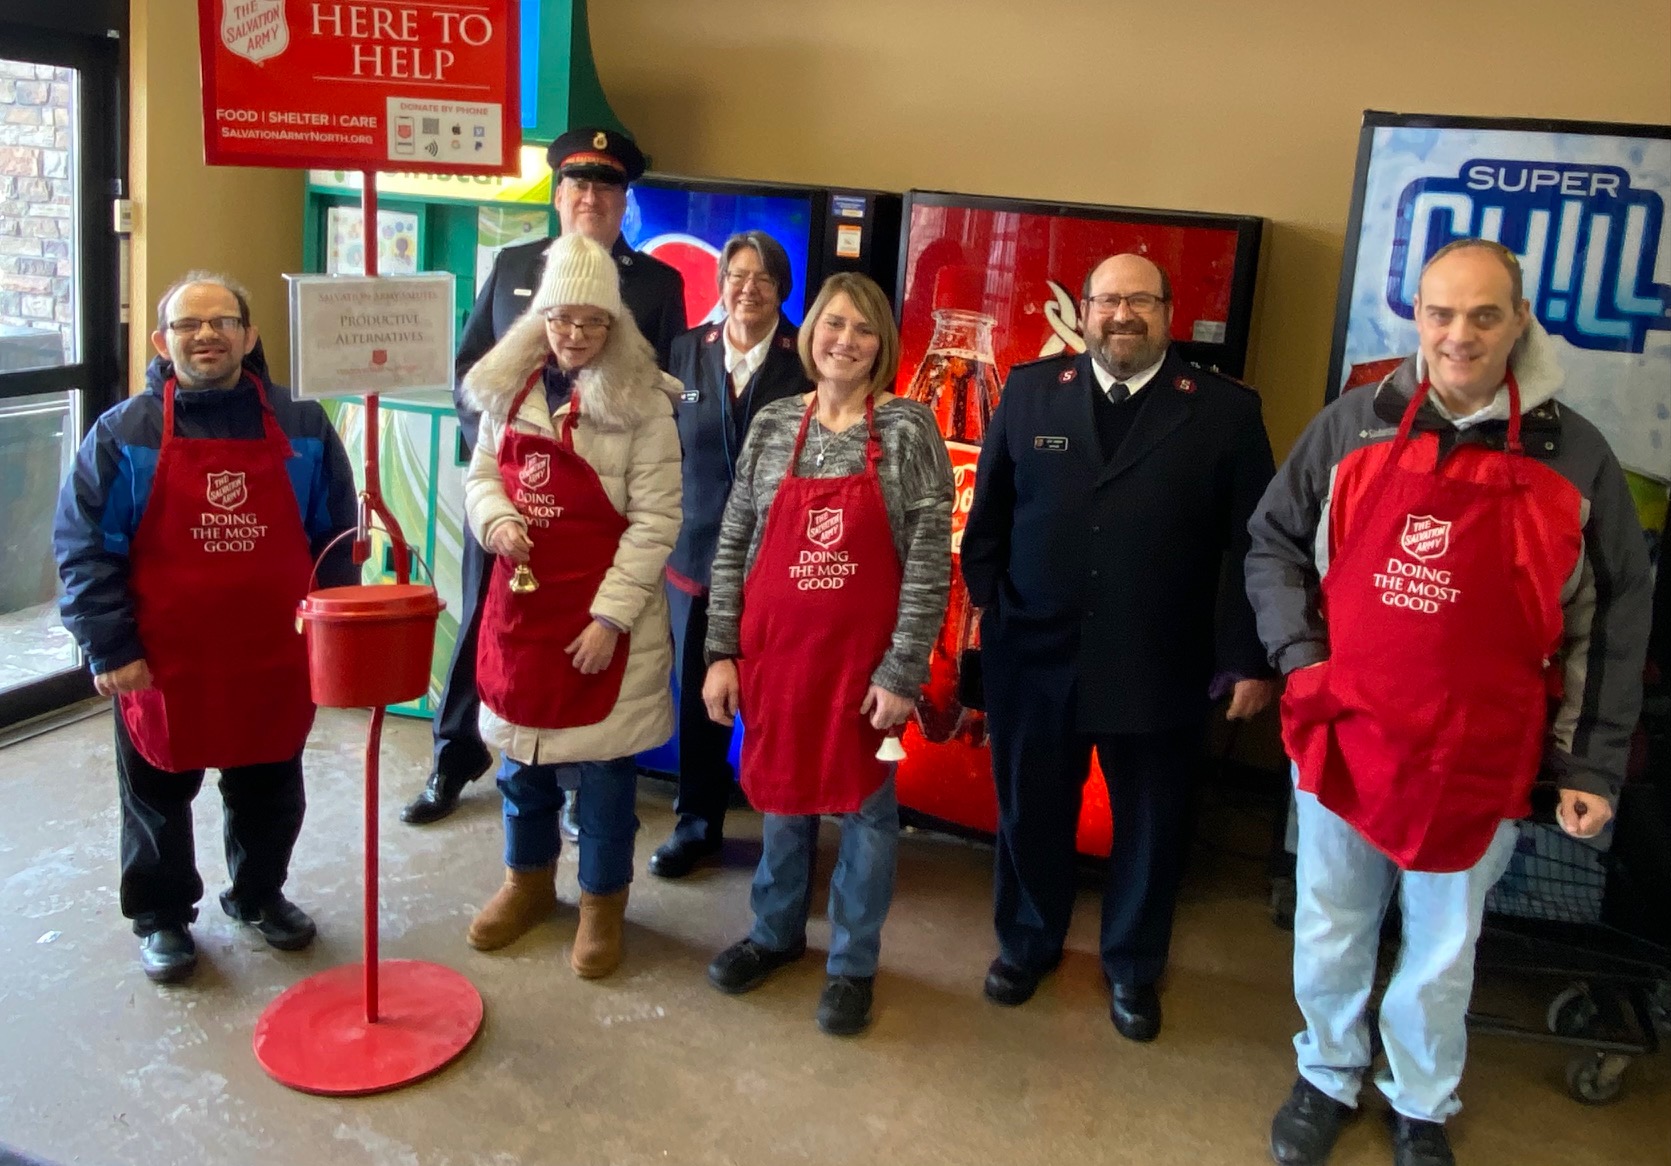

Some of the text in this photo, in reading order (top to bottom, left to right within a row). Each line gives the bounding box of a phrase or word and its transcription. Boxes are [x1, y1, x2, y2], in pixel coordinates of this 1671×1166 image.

[234, 0, 258, 20] THE
[226, 4, 280, 43] SALVATION
[311, 3, 493, 46] HERE TO
[247, 24, 279, 53] ARMY
[352, 44, 455, 80] HELP
[400, 102, 489, 116] DONATE BY PHONE
[216, 109, 378, 128] FOOD SHELTER CARE
[1466, 165, 1620, 198] SUPER
[340, 314, 419, 327] PRODUCTIVE
[335, 332, 423, 345] ALTERNATIVES
[517, 489, 555, 505] DOING
[201, 512, 257, 526] DOING
[528, 505, 564, 518] MOST
[190, 525, 268, 539] THE MOST
[1413, 520, 1432, 533] THE
[1404, 526, 1446, 546] SALVATION
[204, 540, 255, 552] GOOD
[1414, 538, 1442, 554] ARMY
[799, 550, 849, 564] DOING
[789, 563, 859, 578] THE MOST
[1387, 558, 1452, 585] DOING
[797, 577, 844, 591] GOOD
[1373, 573, 1462, 603] THE MOST
[1382, 591, 1439, 614] GOOD
